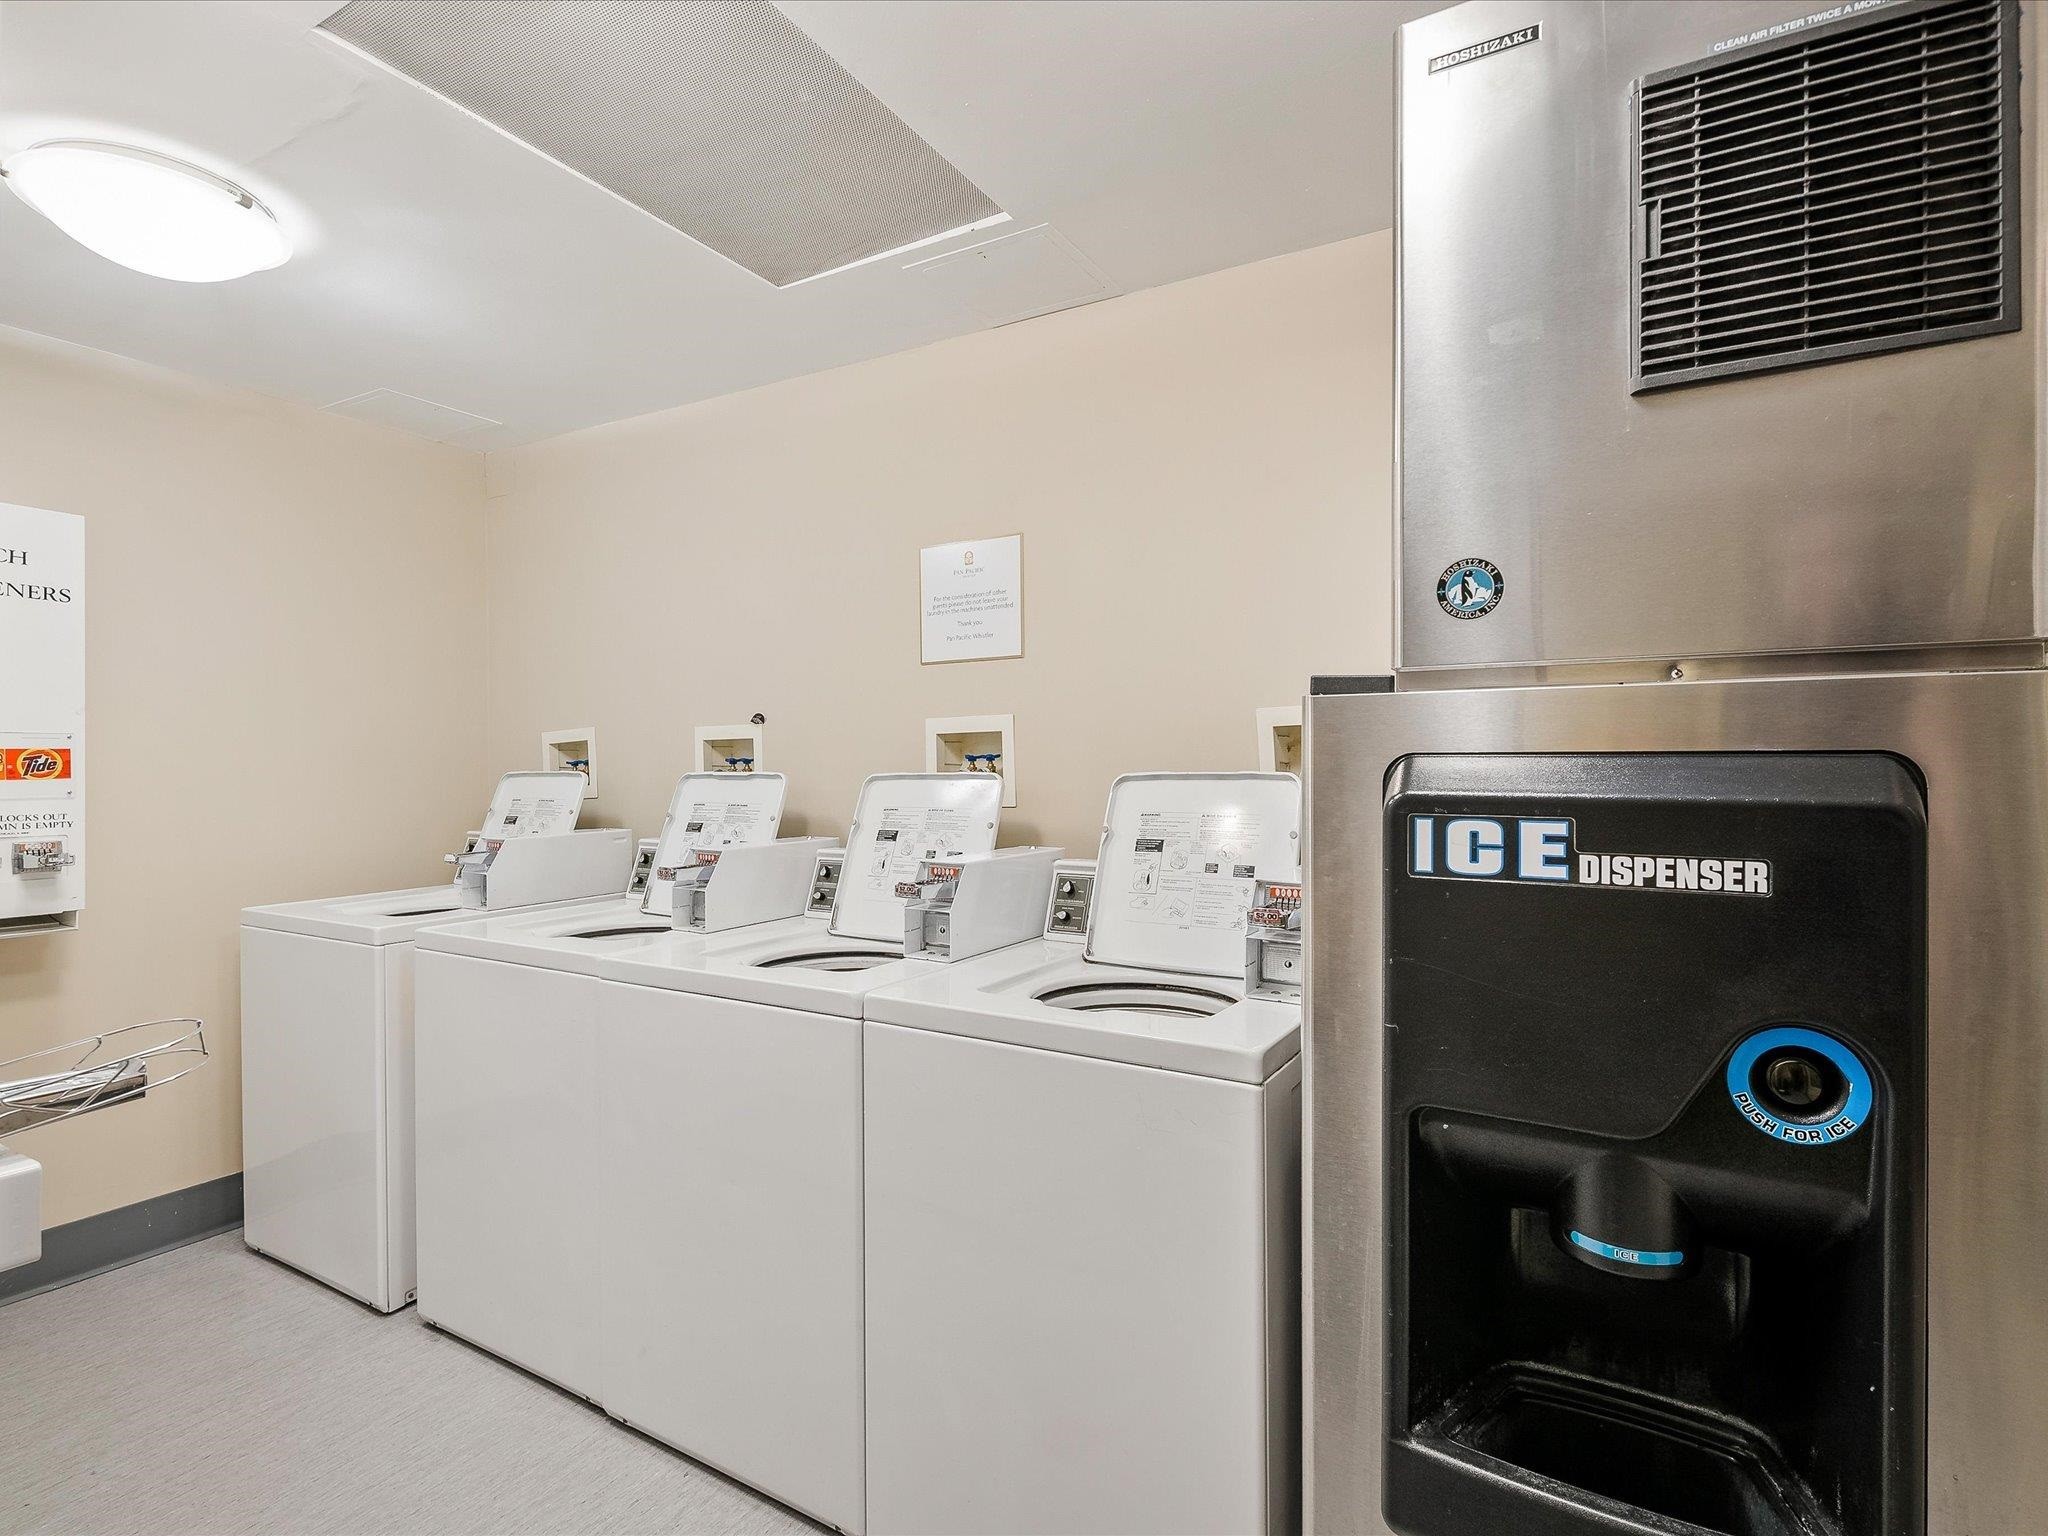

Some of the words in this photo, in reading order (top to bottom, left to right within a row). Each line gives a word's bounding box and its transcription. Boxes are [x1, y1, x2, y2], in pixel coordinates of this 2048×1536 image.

[1714, 35, 1748, 51] CLEAN
[1750, 29, 1767, 41] AIR
[1770, 19, 1805, 36] FILTER
[1807, 7, 1842, 24] TWICE
[1844, 4, 1853, 14] A
[1854, 0, 1886, 11] MON
[1436, 28, 1533, 68] HOSHIZAKI
[1441, 559, 1499, 582] HOSHIZAKI
[1441, 600, 1486, 619] AMERICA,
[1485, 594, 1502, 612] INC.
[22, 754, 58, 777] Tide
[0, 813, 39, 823] LOCKS
[43, 812, 68, 821] OUT
[22, 822, 31, 830] IS
[36, 820, 74, 829] EMPTY
[1414, 816, 1569, 880] ICE
[1579, 854, 1768, 893] DISPENSER
[1255, 912, 1278, 920] $2.00
[1733, 1092, 1779, 1134] PUSH
[1781, 1126, 1824, 1143] FOR
[1824, 1115, 1857, 1139] ICE
[1614, 1248, 1639, 1262] ICE
